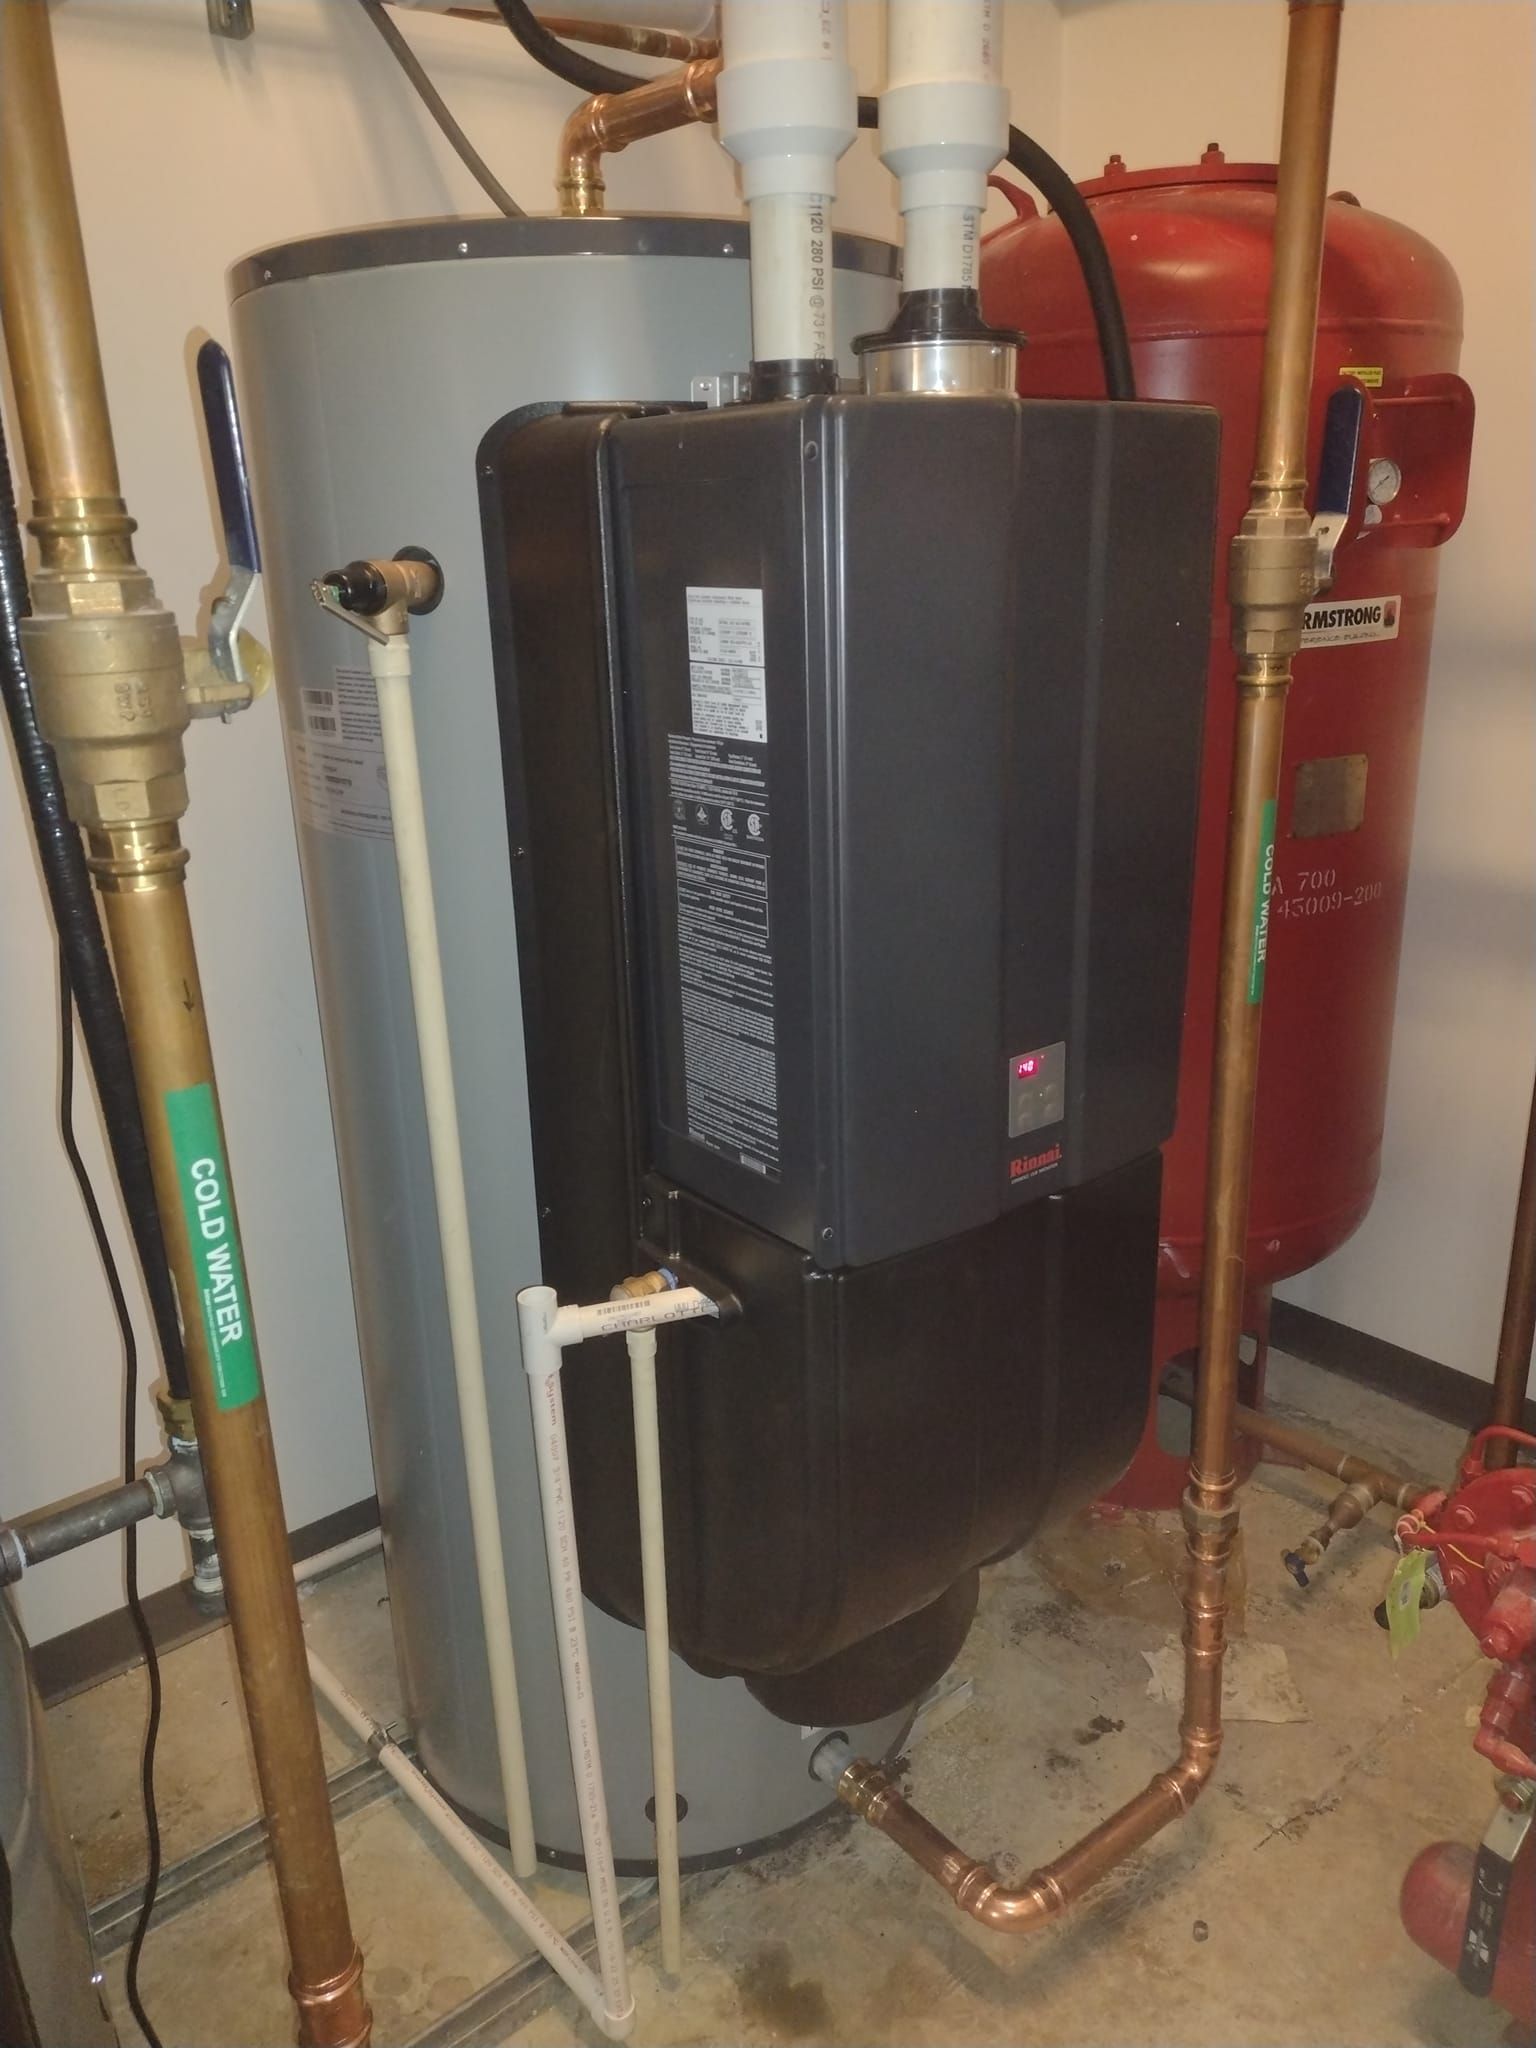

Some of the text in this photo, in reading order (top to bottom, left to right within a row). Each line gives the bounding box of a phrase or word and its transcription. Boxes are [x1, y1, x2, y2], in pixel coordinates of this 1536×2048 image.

[963, 212, 975, 241] STM
[811, 240, 824, 264] 280
[811, 268, 825, 291] PSI
[809, 295, 825, 307] @
[813, 313, 826, 327] 73
[1303, 606, 1382, 630] RMSTRONG
[1298, 869, 1336, 892] 700
[1257, 844, 1275, 963] COLD WATER
[1009, 1144, 1062, 1178] Rinnai
[191, 1158, 226, 1240] COLD
[206, 1242, 243, 1346] WATER
